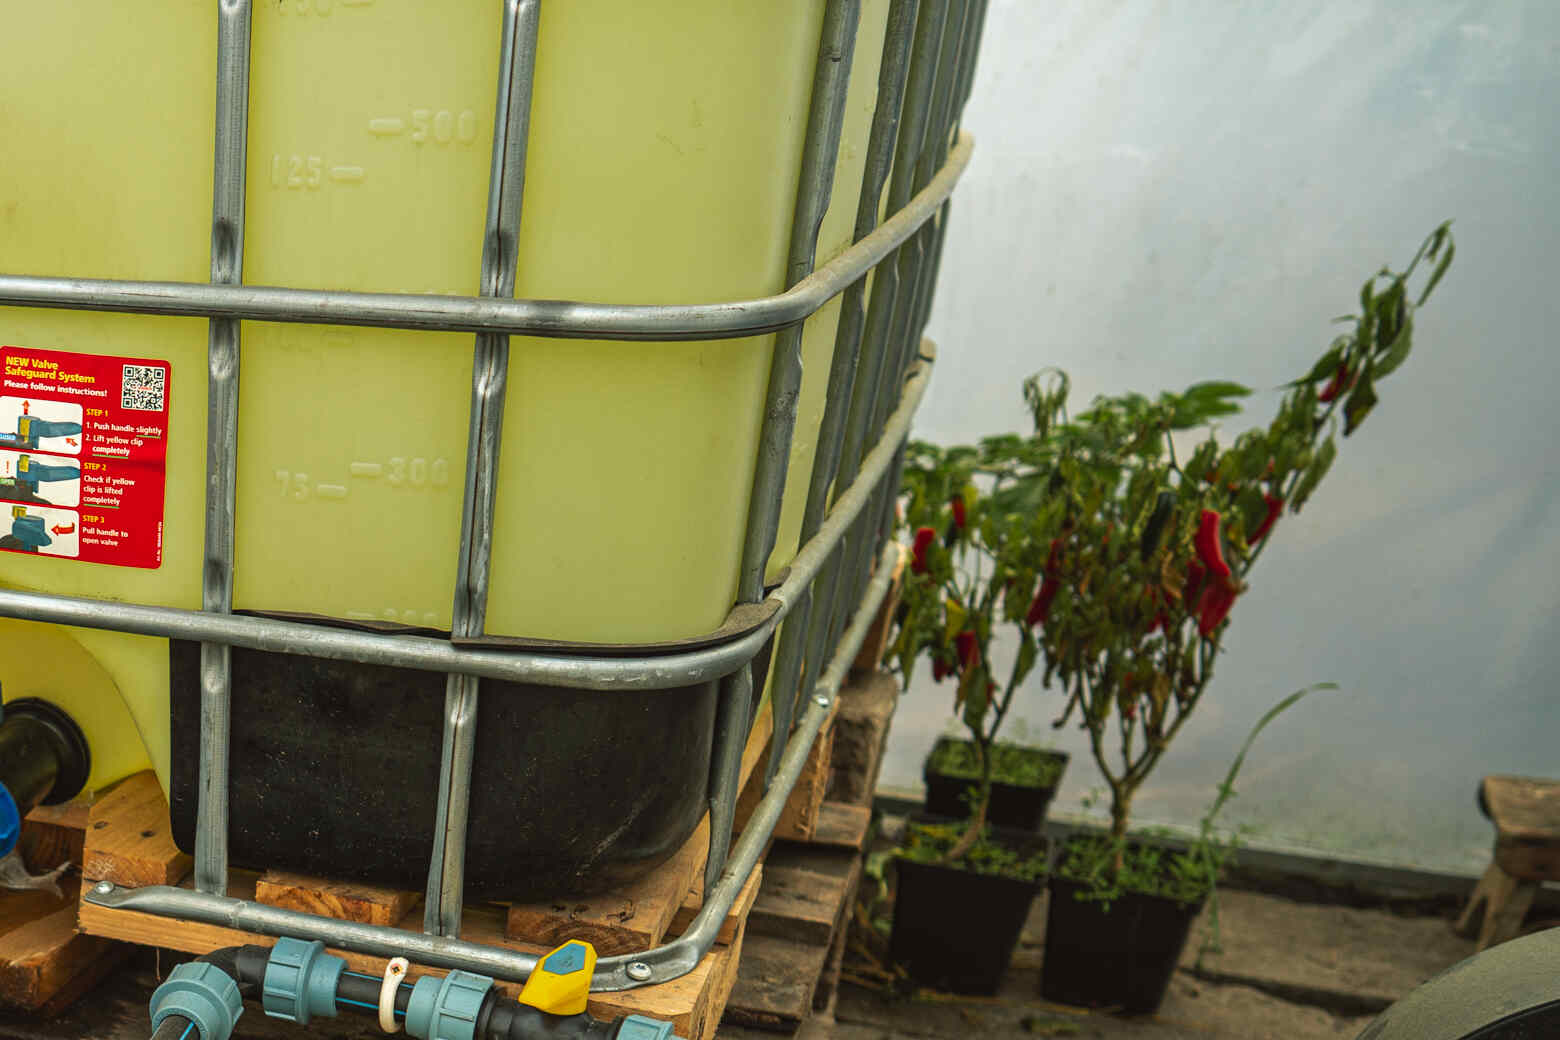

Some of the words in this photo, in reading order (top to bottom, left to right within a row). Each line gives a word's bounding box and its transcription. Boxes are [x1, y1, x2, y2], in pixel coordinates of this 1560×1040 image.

[5, 356, 29, 367] NEW
[31, 358, 58, 370] Valve
[4, 365, 56, 380] Safeguard
[58, 370, 96, 384] System
[3, 380, 28, 390] Please
[30, 382, 56, 393] follow
[57, 385, 108, 397] instructions!
[86, 408, 103, 417] STEP
[93, 422, 110, 431] Push
[111, 423, 135, 433] handle
[136, 426, 162, 436] slightly
[93, 434, 105, 443] Lift
[106, 436, 129, 446] yellow
[130, 438, 144, 447] clip
[92, 445, 130, 456] completely
[83, 462, 101, 471] STEP
[83, 475, 104, 484] Check
[112, 478, 136, 487] yellow
[83, 485, 96, 495] clip
[104, 487, 123, 495] lifted
[83, 496, 120, 506] completely
[82, 514, 99, 523] STEP
[82, 527, 95, 536] Pull
[96, 528, 119, 537] handle
[82, 537, 98, 546] open
